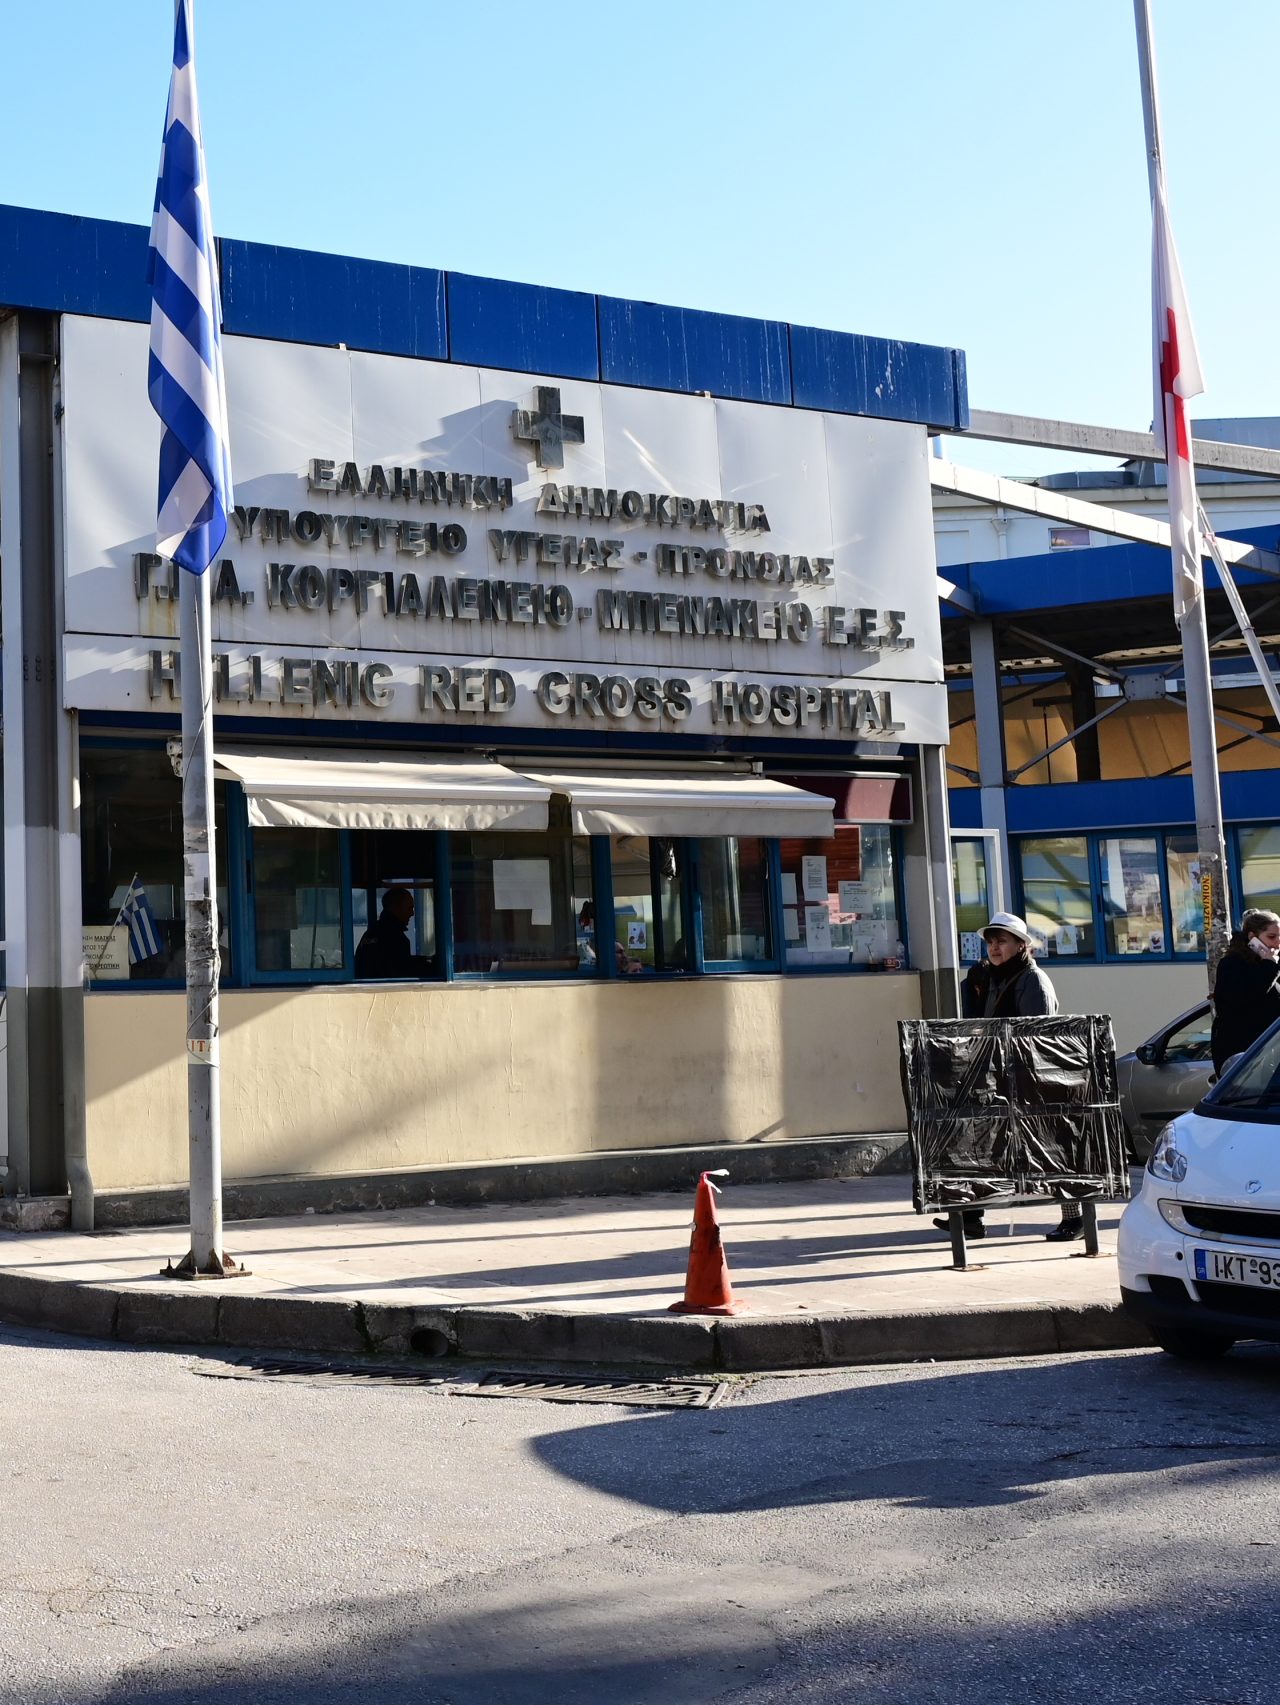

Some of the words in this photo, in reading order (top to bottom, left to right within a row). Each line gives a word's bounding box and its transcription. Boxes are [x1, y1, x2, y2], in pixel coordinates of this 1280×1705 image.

[308, 458, 513, 507] ΕΛΛΗΝΙΚΗ
[536, 482, 771, 532] ΔΗΜΟΚΡΑΤΙΑ
[232, 505, 468, 554] ΥΠΟΥΡΓΕΙΟ
[488, 528, 625, 570] ΥΓΕΙΑΣ
[657, 543, 835, 585] ΠΡΟΝΟΙΑΣ
[149, 650, 395, 708] HLLENIC
[419, 664, 517, 713] RED
[536, 671, 692, 720] CROSS
[710, 680, 906, 731] HOSPITAL
